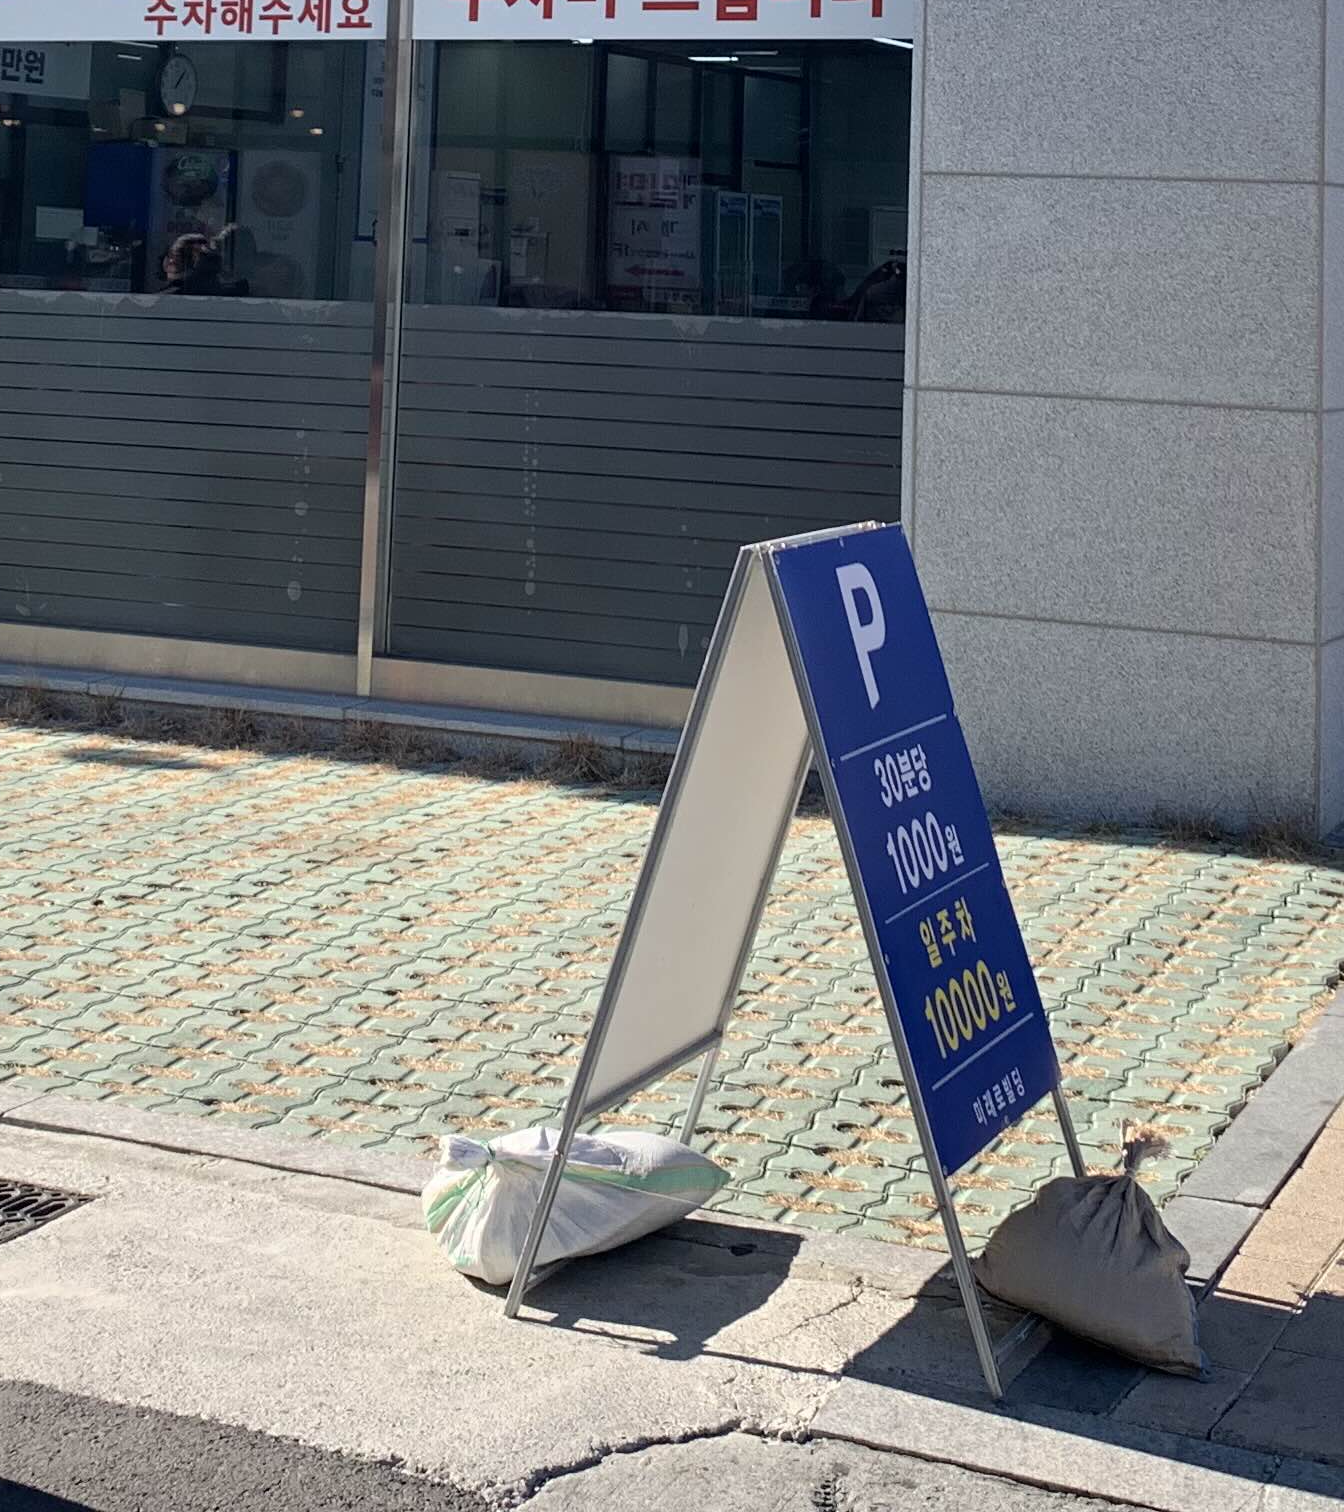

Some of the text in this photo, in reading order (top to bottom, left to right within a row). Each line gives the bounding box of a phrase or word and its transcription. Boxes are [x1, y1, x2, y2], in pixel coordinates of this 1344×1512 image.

[835, 562, 886, 710] P
[873, 742, 933, 809] 30분당
[885, 810, 965, 895] 1000원
[924, 959, 1018, 1060] 10000원
[972, 1066, 1025, 1126] 미래로빌딩
